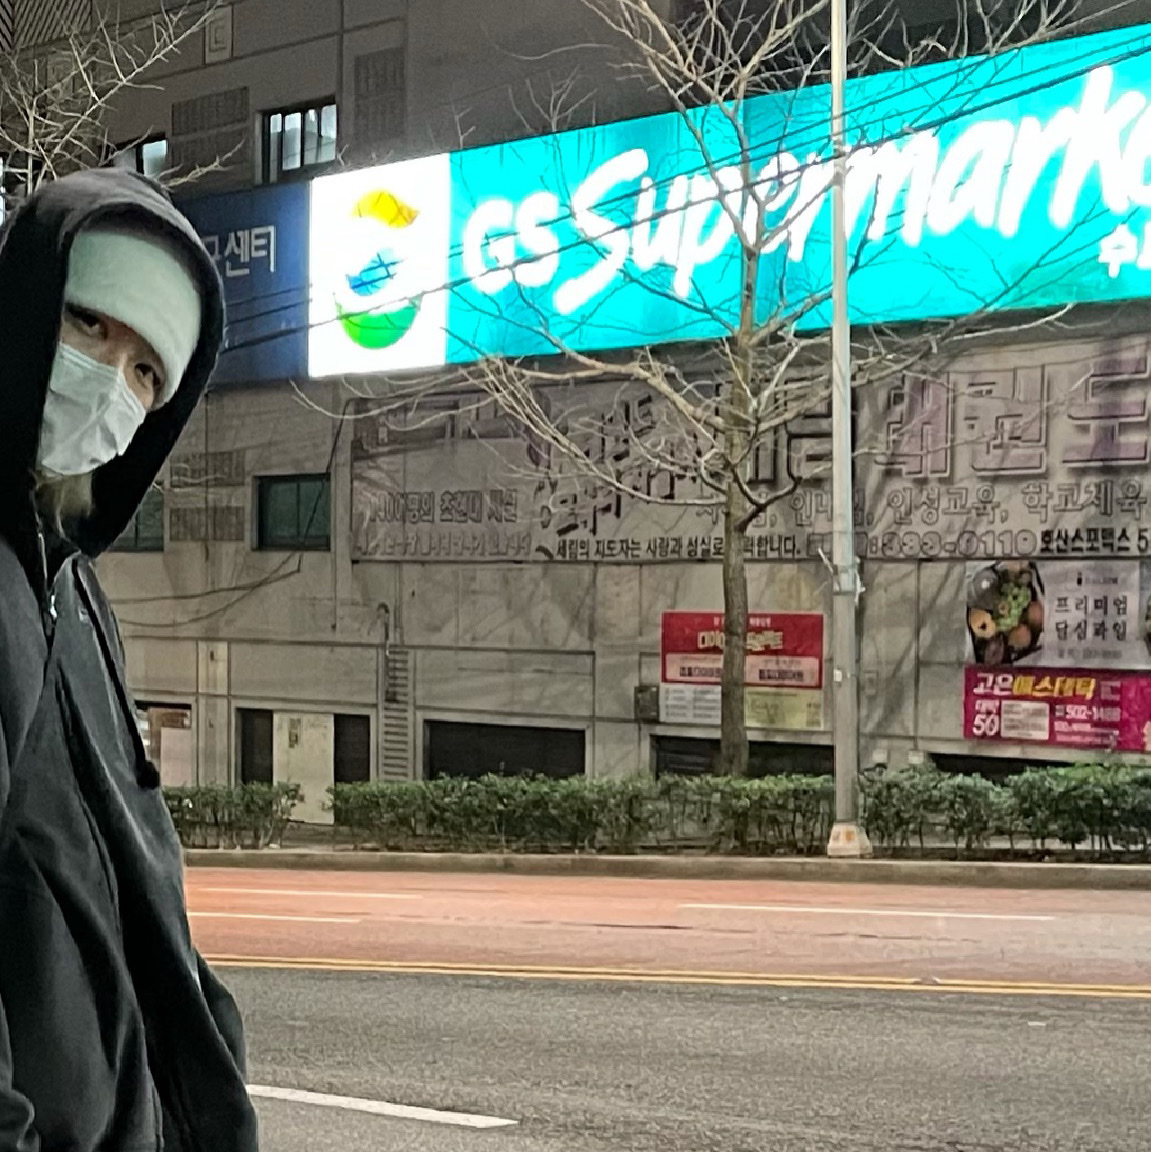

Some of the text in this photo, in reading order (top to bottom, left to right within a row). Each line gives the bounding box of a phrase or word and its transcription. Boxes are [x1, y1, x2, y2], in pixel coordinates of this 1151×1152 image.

[462, 190, 561, 296] GS
[887, 483, 1010, 527] 인성교육,
[1021, 477, 1148, 523] 학교체육
[556, 537, 590, 560] 세림의
[594, 537, 642, 559] 지도자는
[646, 536, 683, 559] 사람과
[686, 536, 725, 559] 성실로
